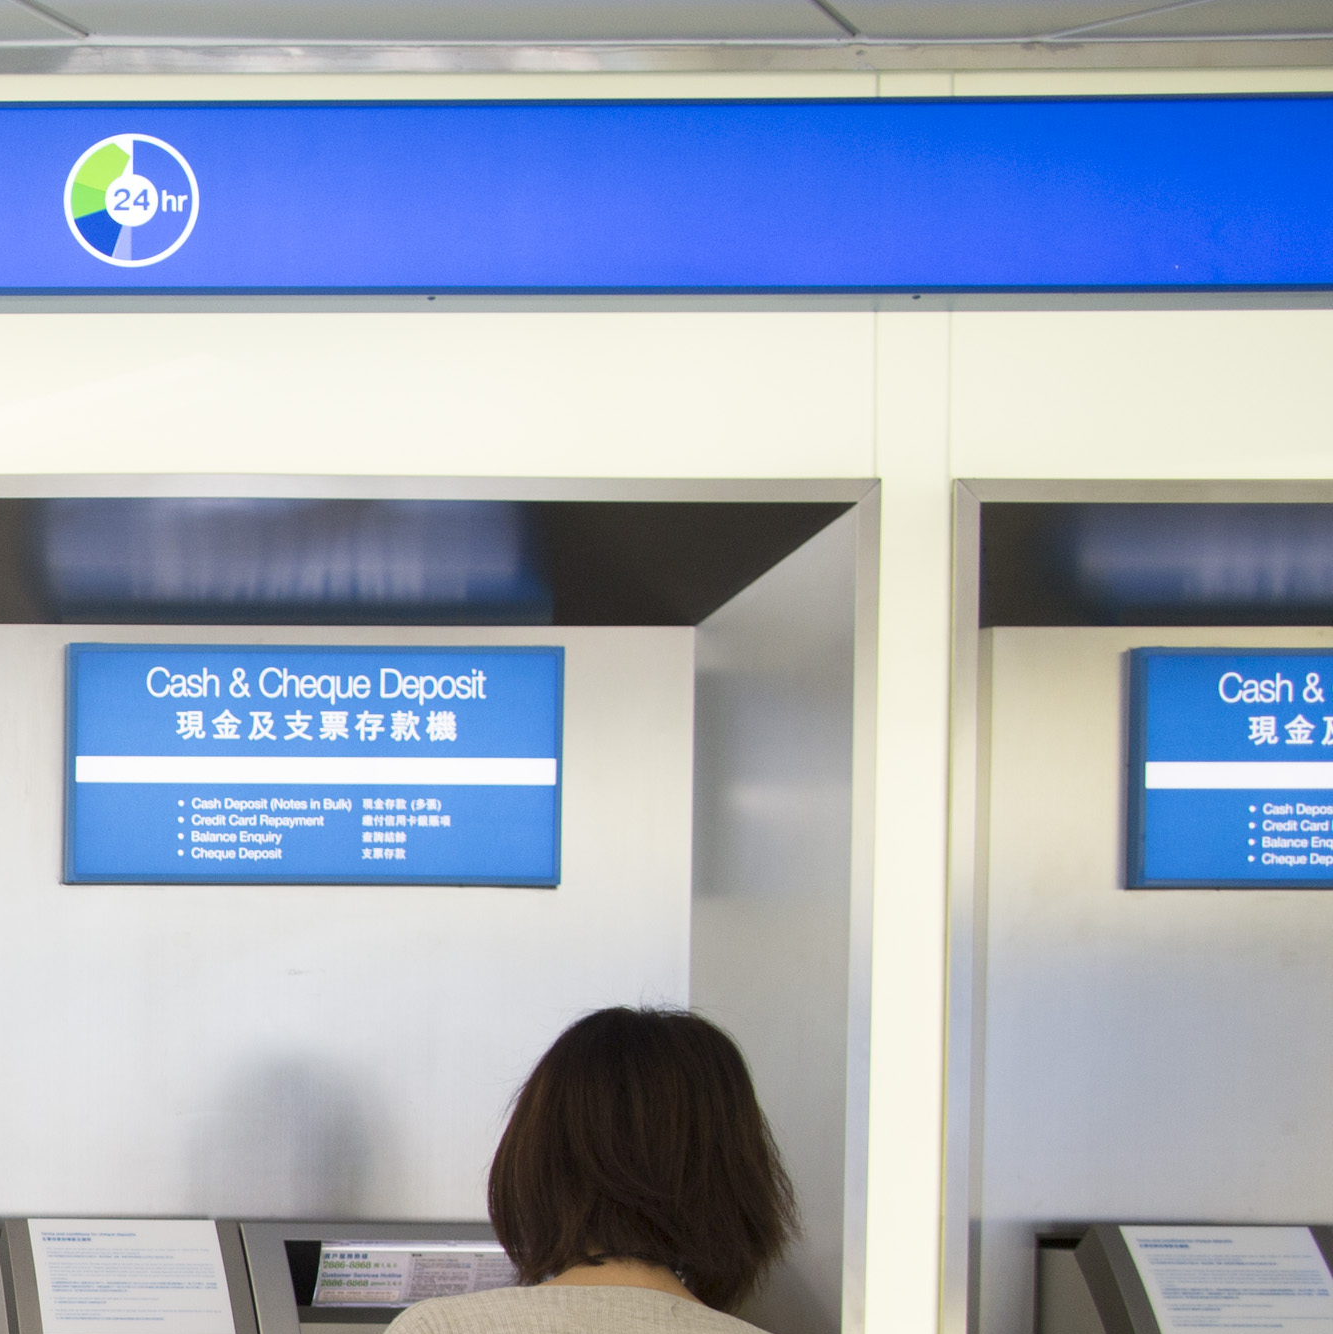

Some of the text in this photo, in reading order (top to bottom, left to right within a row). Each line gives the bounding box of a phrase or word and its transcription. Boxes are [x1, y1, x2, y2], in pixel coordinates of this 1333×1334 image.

[145, 665, 488, 706] Cash & Cheque Deposit
[1217, 671, 1325, 704] Cash &
[175, 709, 459, 742] 現金及支票存款機
[191, 797, 353, 812] Cash Deposit (Notes in Bulk)
[1262, 802, 1294, 816] Cash
[191, 814, 325, 829] Credit Card Repayment
[1261, 819, 1329, 832] Credit Card
[191, 830, 283, 845] Balance Enquiry
[1261, 835, 1309, 849] Balance
[191, 847, 283, 862] Cheque Deposit
[1261, 852, 1308, 867] Cheque
